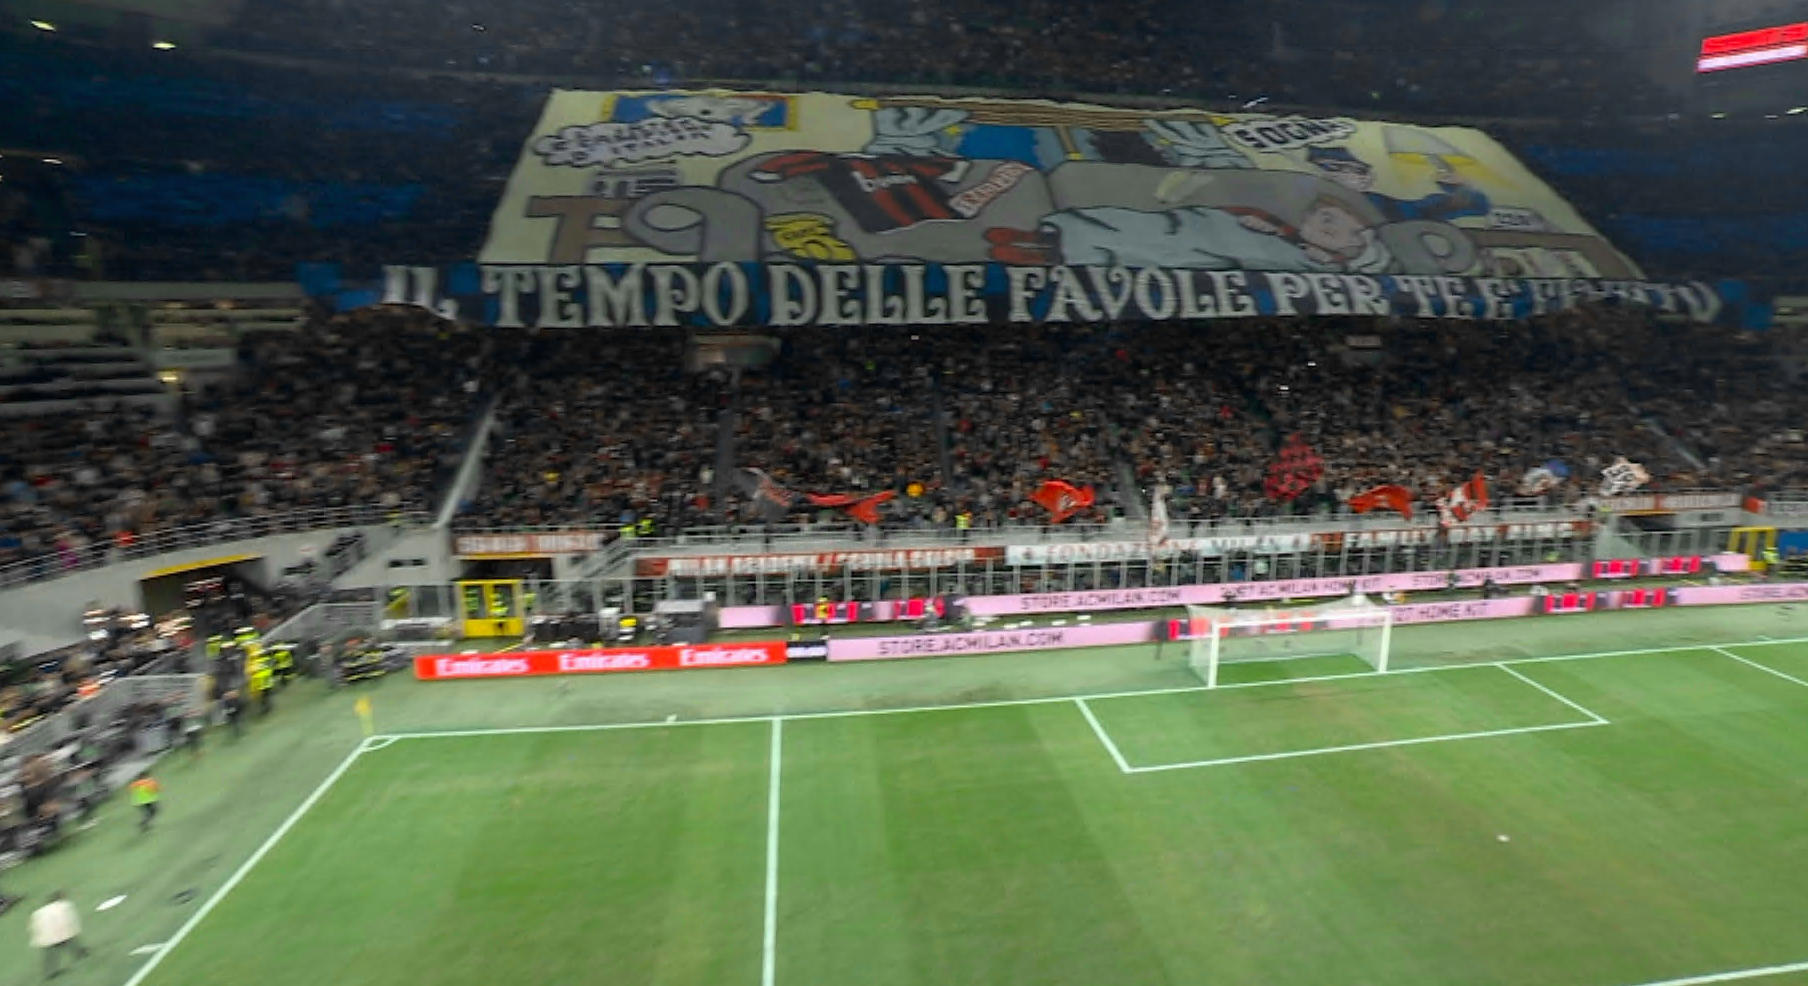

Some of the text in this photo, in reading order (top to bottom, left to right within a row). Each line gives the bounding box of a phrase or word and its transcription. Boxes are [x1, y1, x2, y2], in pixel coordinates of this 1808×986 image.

[481, 261, 748, 328] TEMPO
[767, 263, 988, 325] DELLE
[1006, 263, 1258, 324] FAVOLE
[1265, 271, 1390, 317] PER
[1393, 276, 1475, 319] TE
[1418, 604, 1461, 619] HOME
[877, 632, 1065, 656] STORE.ACMILAN.COM
[435, 657, 530, 679] Emirates
[557, 651, 651, 672] Emirates
[678, 645, 770, 667] Emirates
